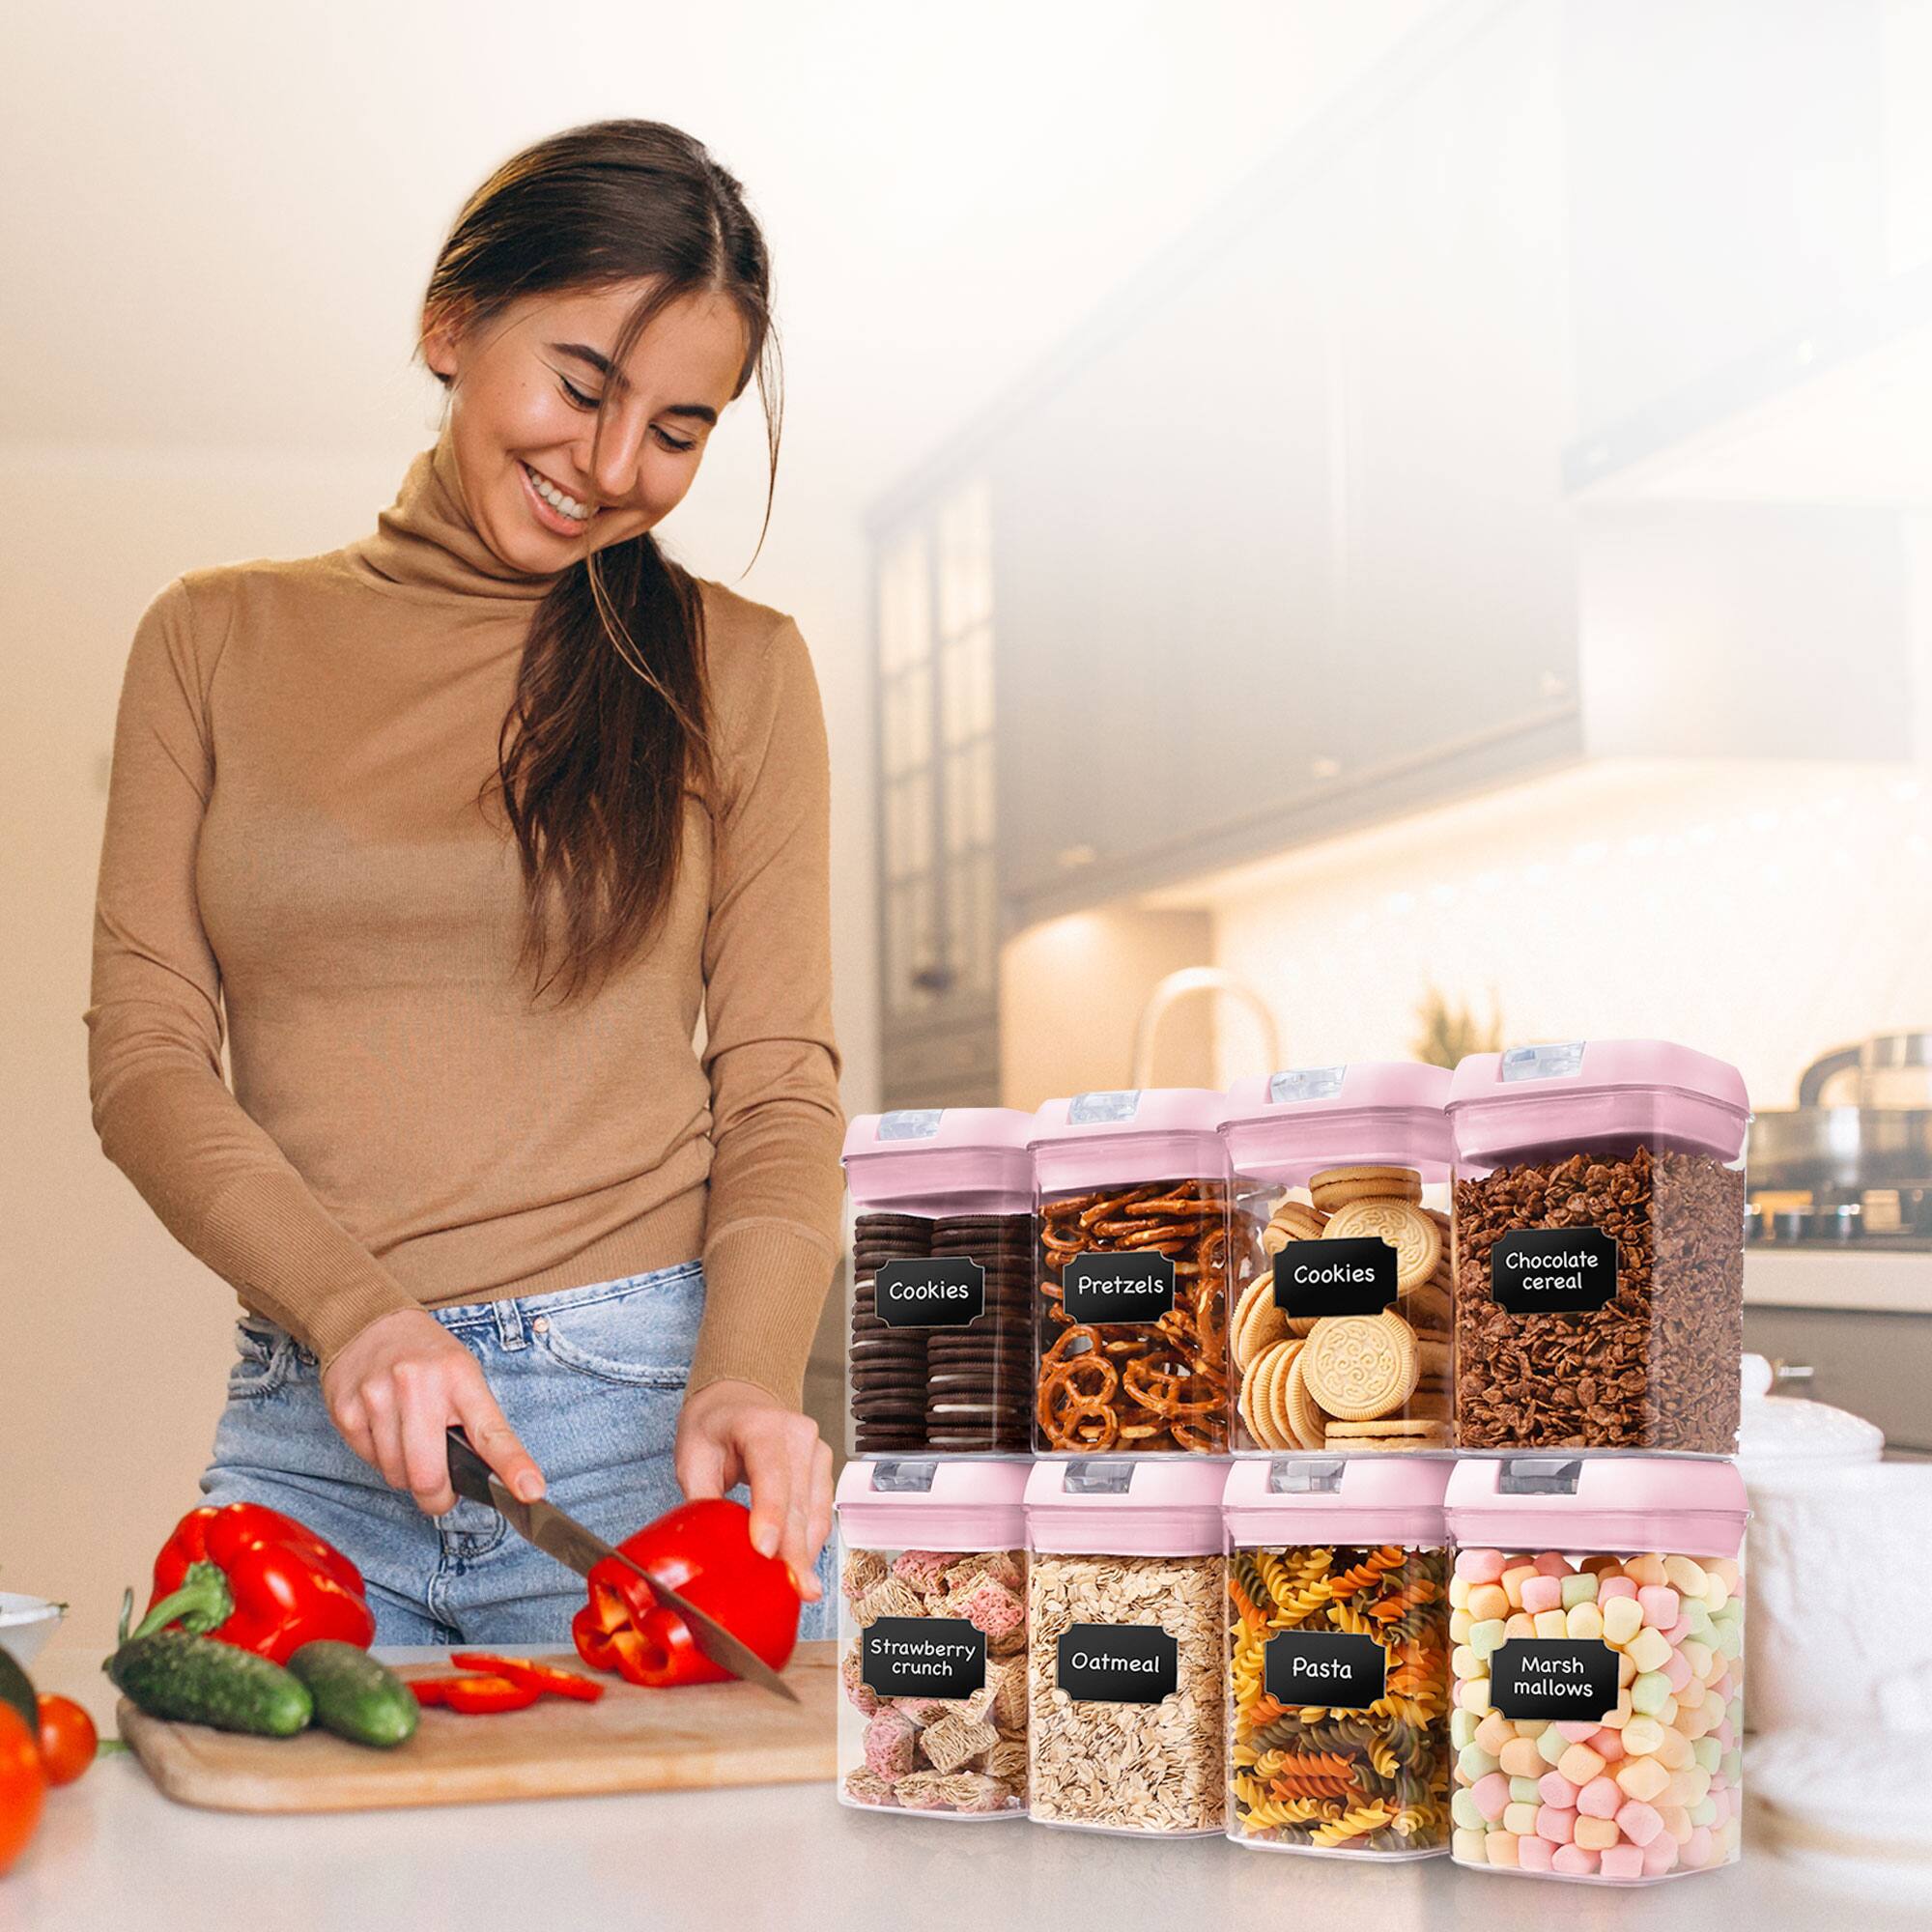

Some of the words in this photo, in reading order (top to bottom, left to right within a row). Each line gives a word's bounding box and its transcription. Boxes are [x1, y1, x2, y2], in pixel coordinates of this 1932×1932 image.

[1505, 1250, 1599, 1269] Chocolate
[1293, 1264, 1376, 1284] Cookies
[1522, 1271, 1582, 1291] cereal
[889, 1280, 969, 1300] Cookies
[1078, 1275, 1165, 1294] Pretzels
[870, 1638, 976, 1662] Strawberry
[892, 1660, 952, 1676] crunch
[1071, 1652, 1160, 1673] Oatmeal
[1293, 1657, 1352, 1679] Pasta
[1521, 1656, 1584, 1674] Marsh
[1514, 1678, 1594, 1697] mallows
